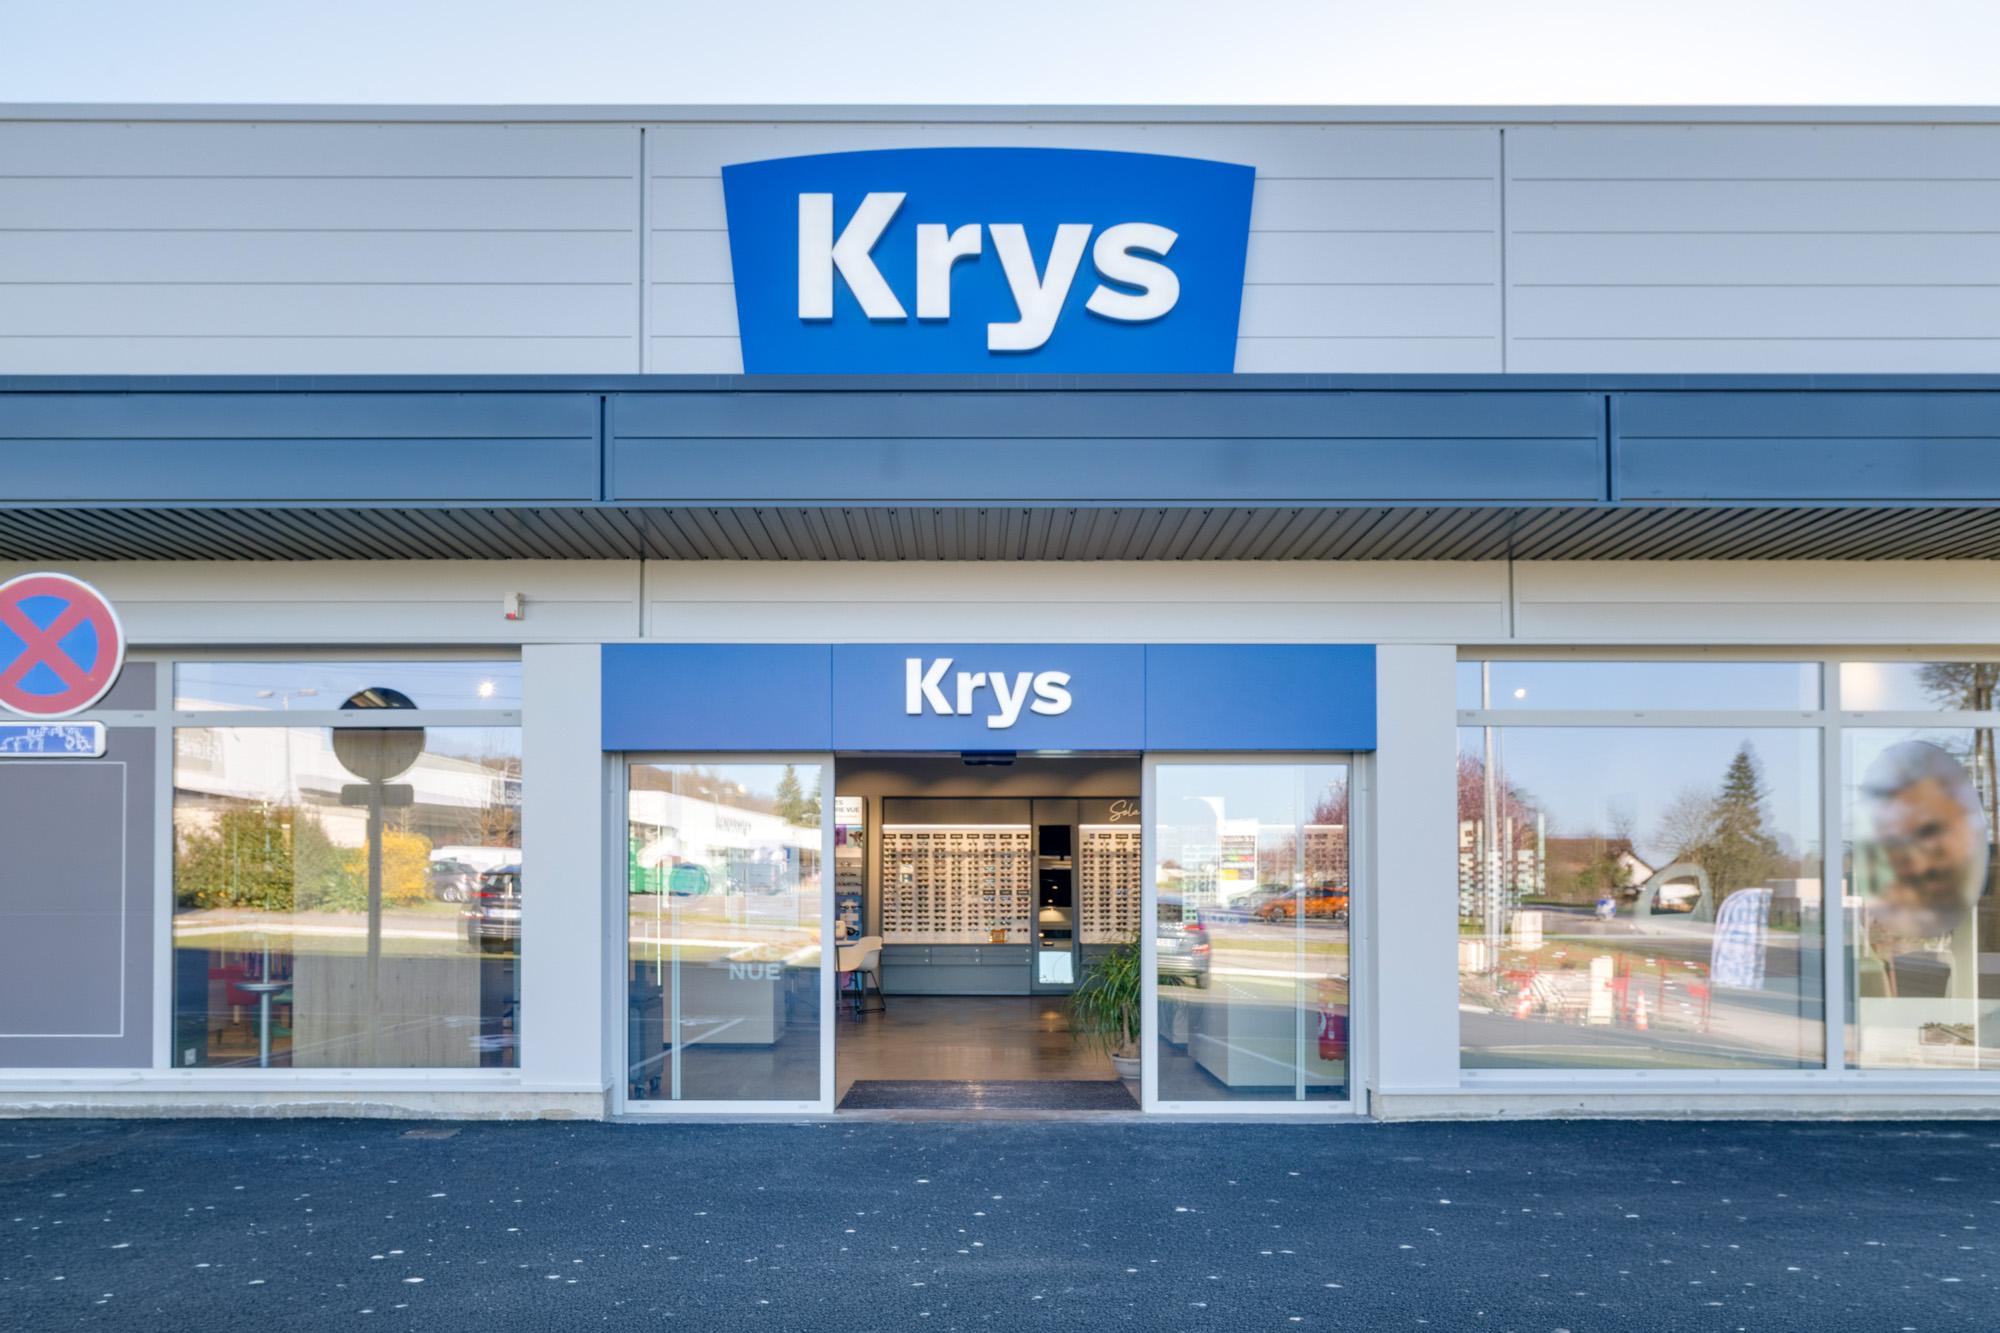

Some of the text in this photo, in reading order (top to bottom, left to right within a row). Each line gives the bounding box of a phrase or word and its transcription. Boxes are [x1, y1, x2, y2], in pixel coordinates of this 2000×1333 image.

[797, 192, 1182, 353] Krys
[905, 658, 1073, 729] Krys
[728, 963, 782, 981] NUE
